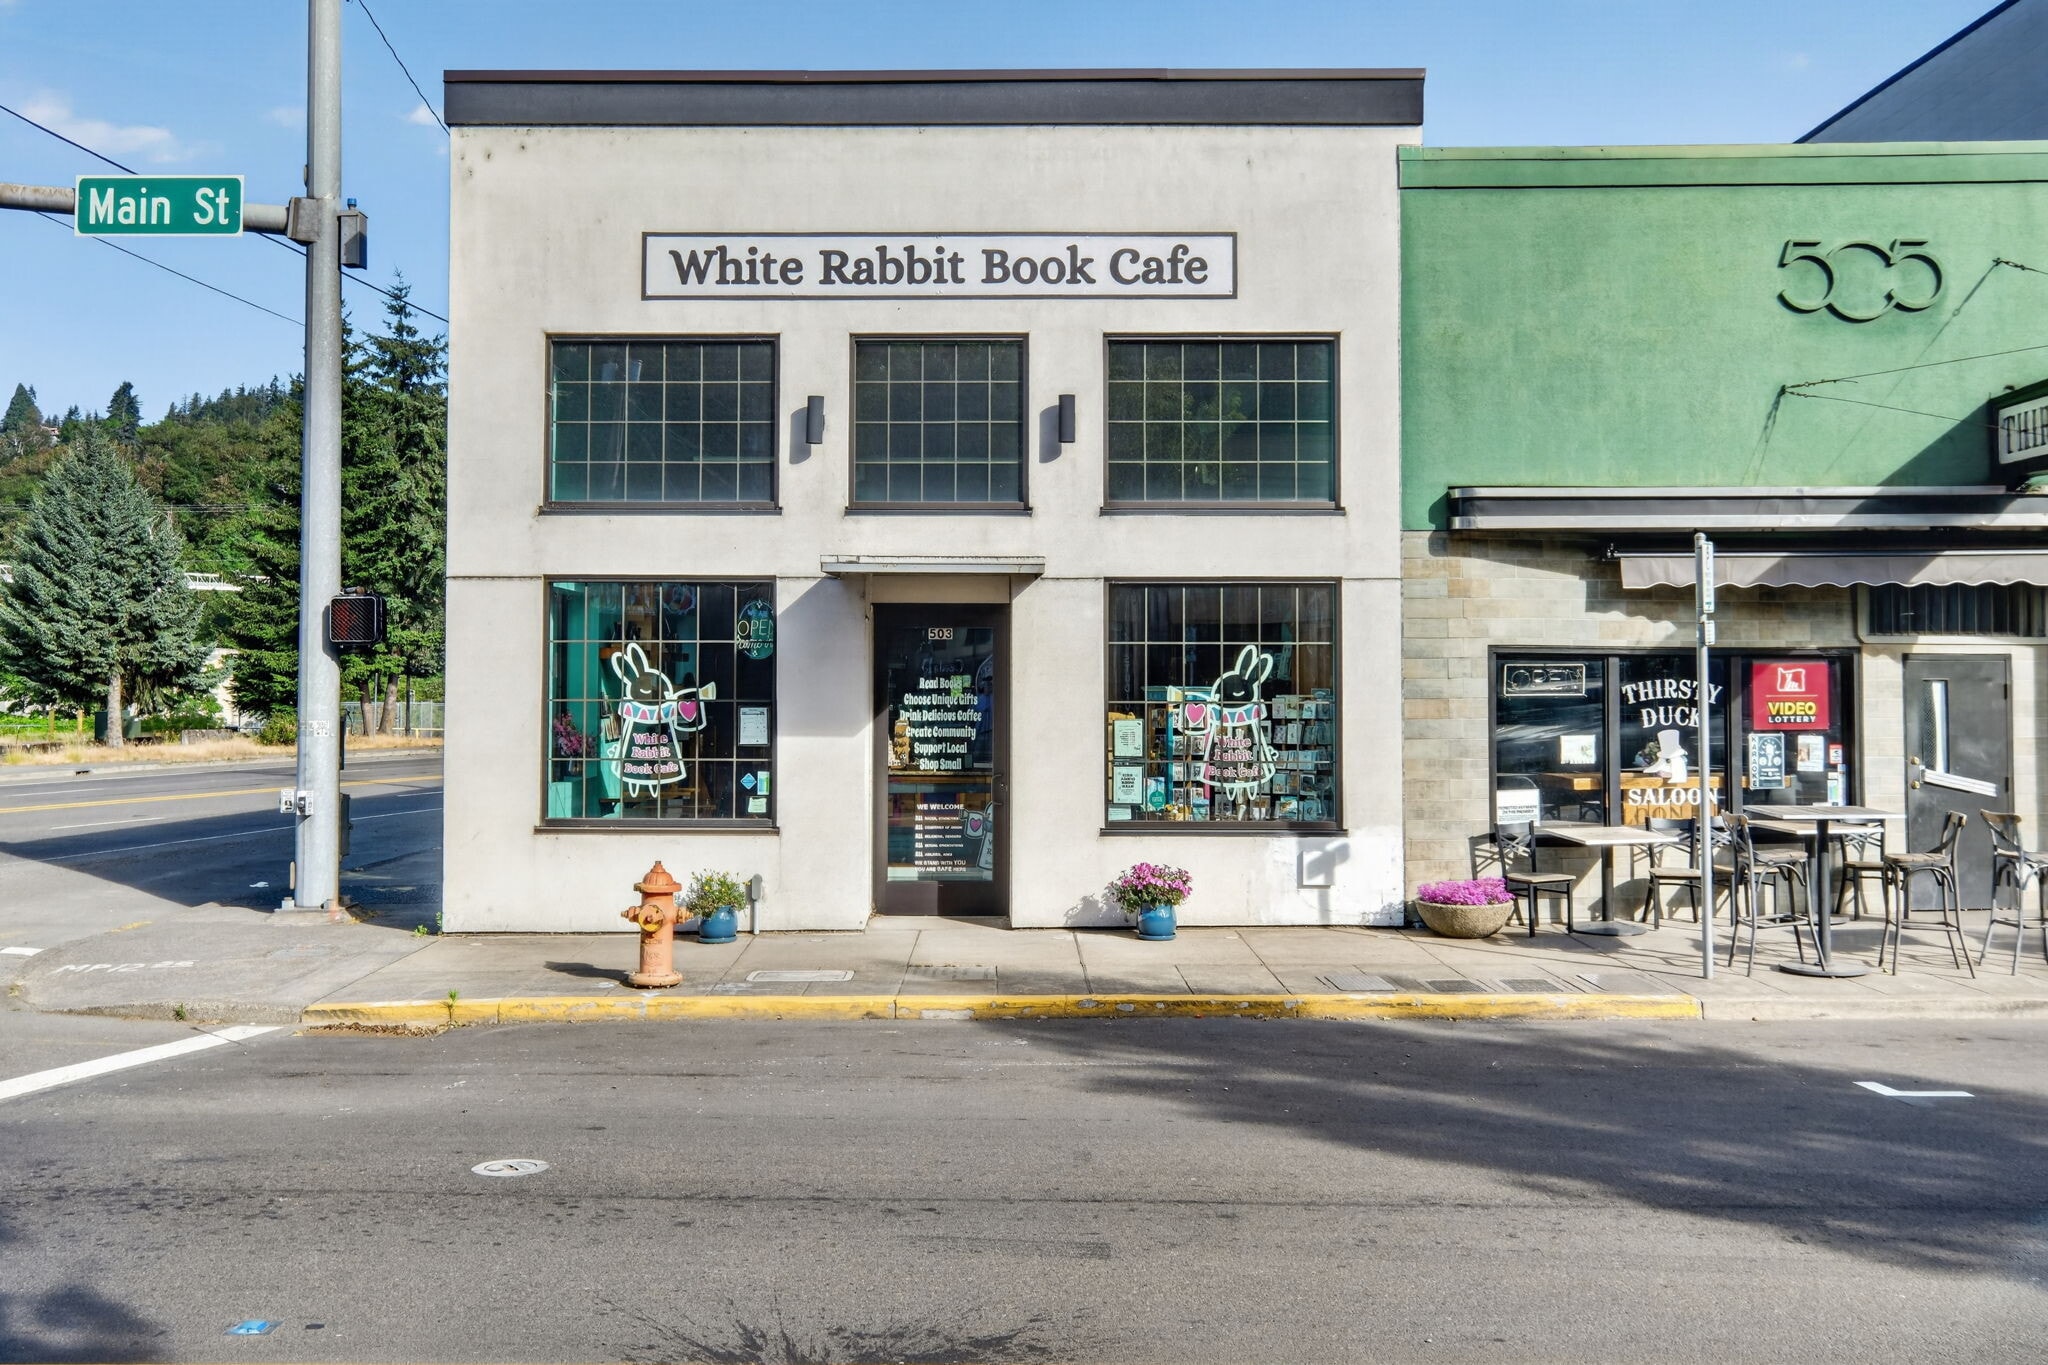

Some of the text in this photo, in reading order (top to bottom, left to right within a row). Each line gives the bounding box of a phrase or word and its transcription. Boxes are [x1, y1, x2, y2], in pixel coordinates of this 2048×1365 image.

[89, 187, 230, 225] Main St
[668, 243, 1209, 287] White Rabbit Book Cafe
[1777, 239, 1942, 324] 505
[930, 629, 952, 639] 503
[919, 677, 938, 689] Read
[904, 693, 978, 708] Choose Unique Gifts
[900, 708, 982, 721] Drink Delicious Coffee
[1767, 702, 1817, 715] VIDEO
[1640, 705, 1700, 728] DUCK
[633, 733, 669, 745] Whie
[905, 725, 977, 741] Create Community
[914, 742, 968, 756] Support Local
[624, 763, 653, 775] Book
[920, 758, 962, 772] Shop Small
[1628, 788, 1718, 806] SALOON
